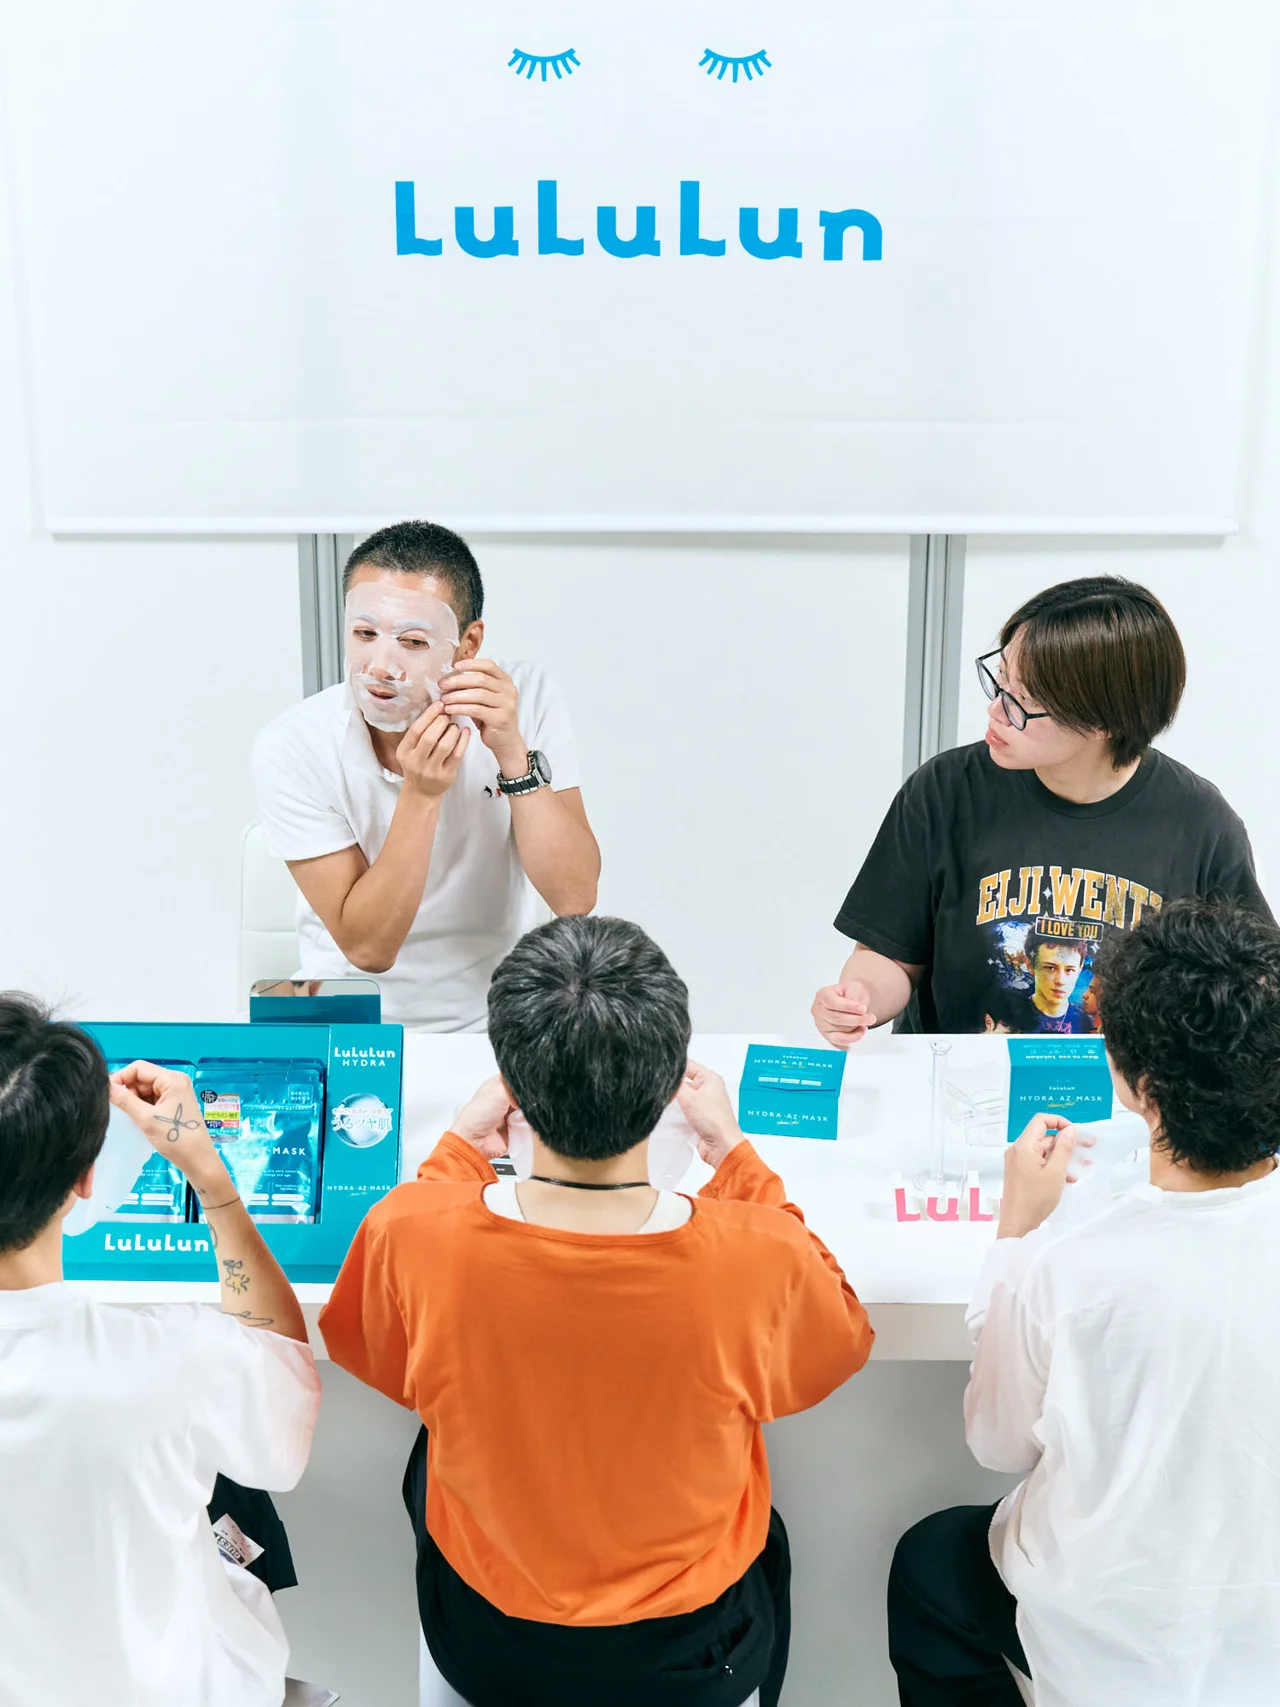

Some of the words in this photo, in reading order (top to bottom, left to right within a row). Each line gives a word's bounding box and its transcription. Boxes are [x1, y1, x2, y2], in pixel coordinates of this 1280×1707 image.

[395, 179, 883, 261] LuLuLun
[976, 866, 1044, 926] EIJI
[1040, 920, 1045, 934] I
[1047, 921, 1074, 937] LOVE
[1077, 924, 1098, 939] YOU
[334, 1046, 396, 1058] LuLuLun
[342, 1059, 386, 1067] HYDRA
[748, 1110, 781, 1118] HYDRA
[802, 1114, 828, 1122] MASK
[272, 1147, 306, 1156] MASK
[895, 1187, 1003, 1222] LuL
[105, 1233, 209, 1252] LuLuLun
